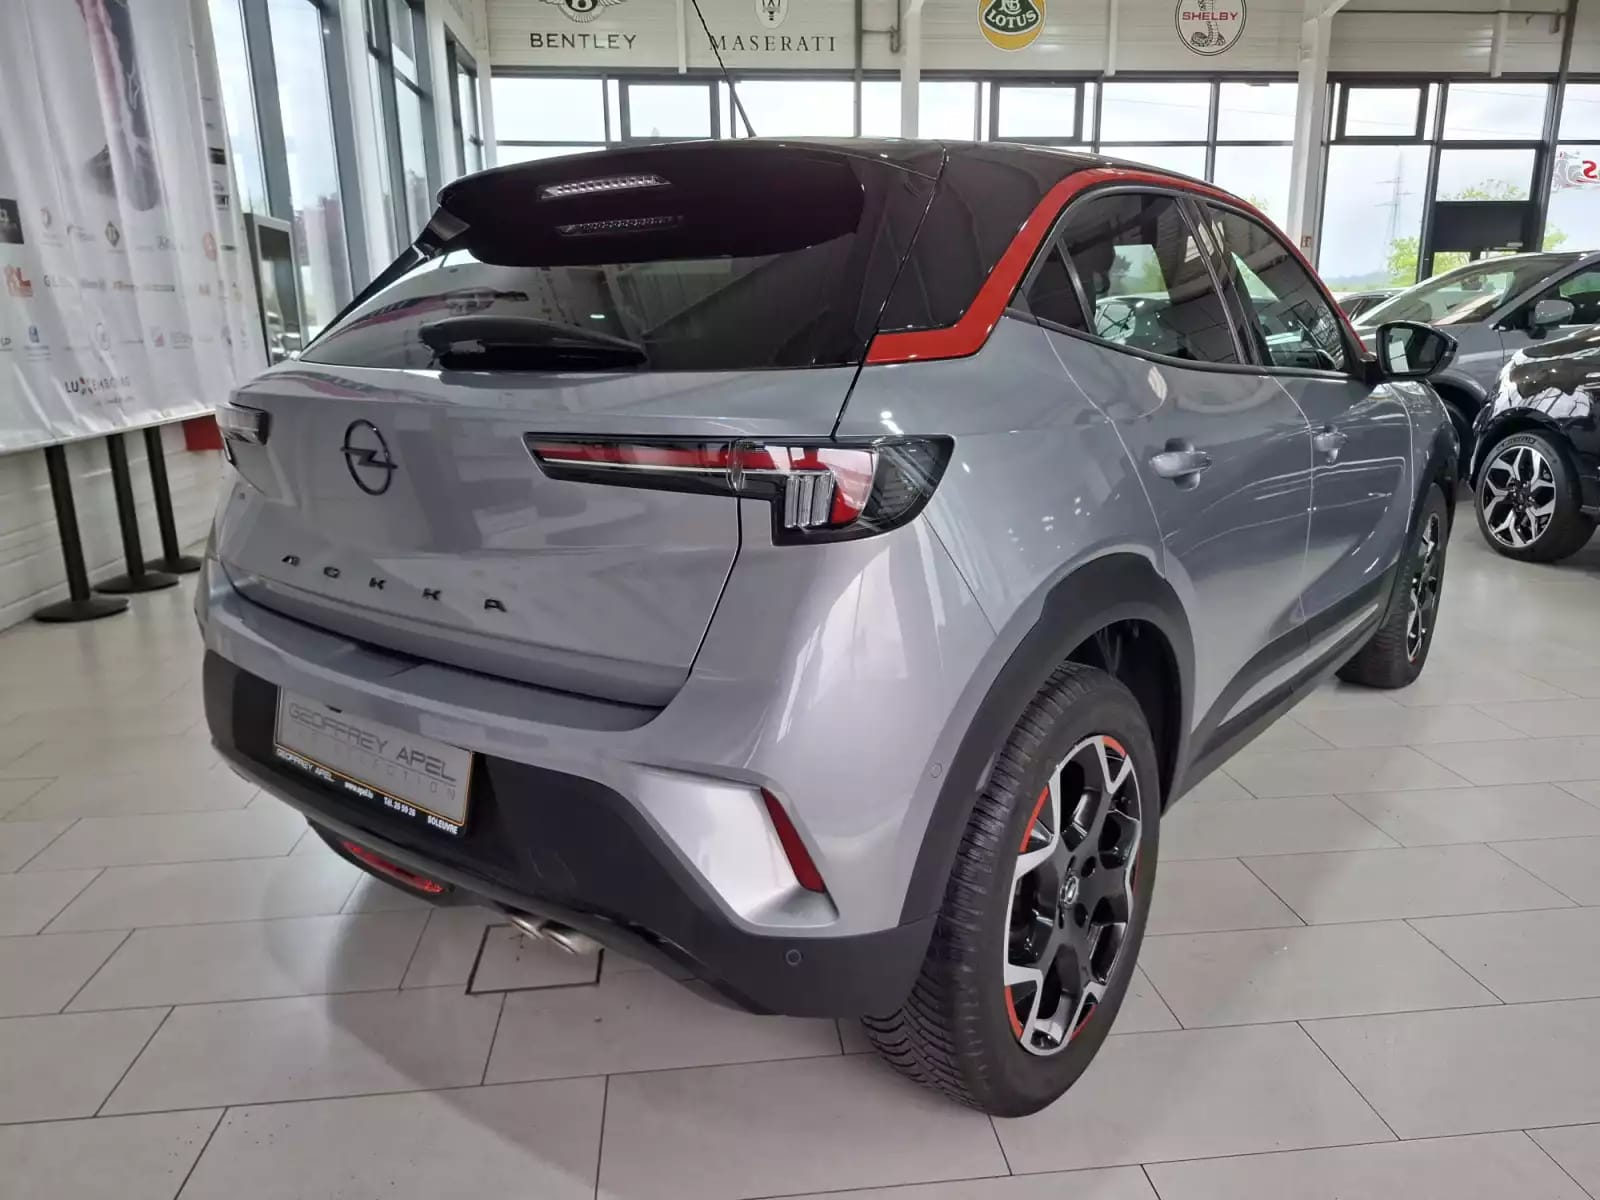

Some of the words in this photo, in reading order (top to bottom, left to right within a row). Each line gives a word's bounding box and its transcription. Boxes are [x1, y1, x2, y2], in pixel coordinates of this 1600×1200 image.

[987, 9, 1037, 28] LOTUS
[1182, 11, 1238, 21] SHELBY
[530, 32, 637, 50] BENTLEY
[709, 34, 835, 52] MASERATI
[288, 702, 389, 753] GEOFFREY
[395, 746, 457, 783] APEL
[427, 815, 459, 835] SOLEUVRE
